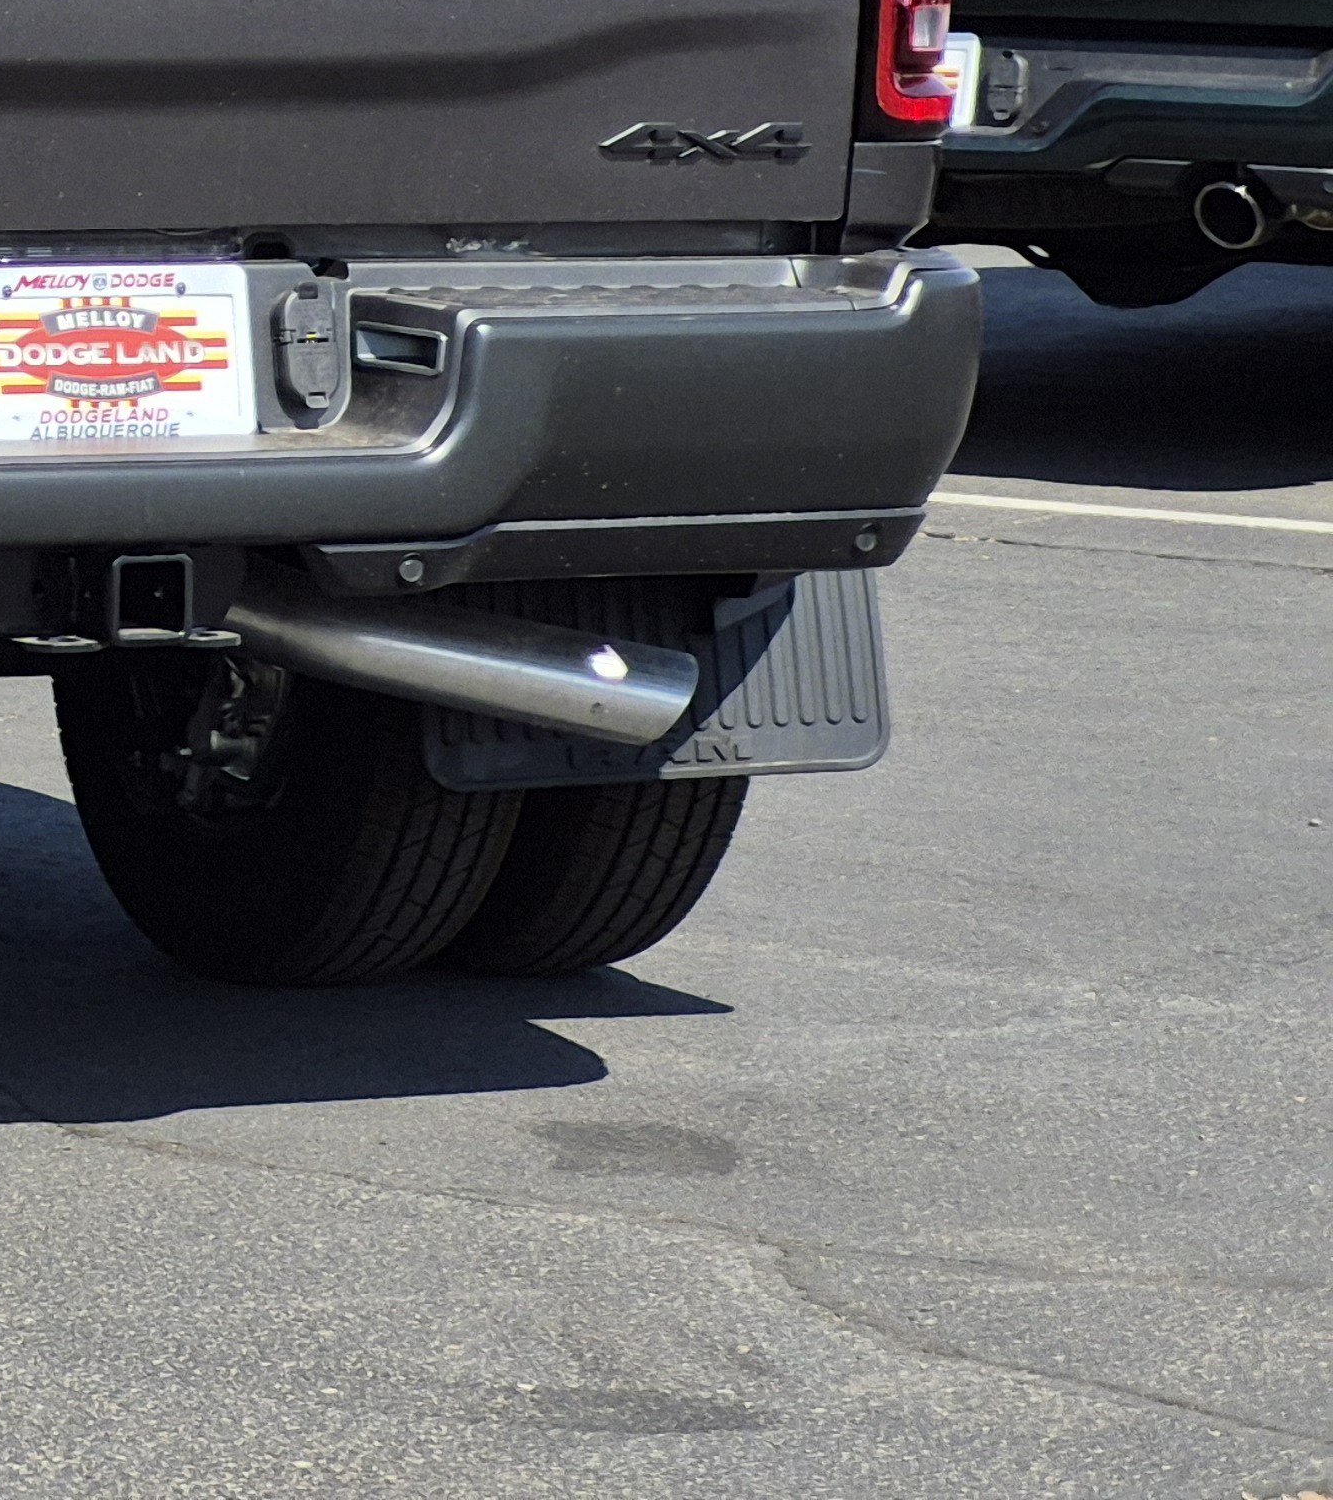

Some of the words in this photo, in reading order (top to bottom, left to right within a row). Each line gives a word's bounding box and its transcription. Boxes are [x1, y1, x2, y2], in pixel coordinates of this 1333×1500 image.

[14, 273, 91, 292] MELLOY
[111, 273, 176, 289] DODGE
[55, 309, 147, 331] MELLOY
[40, 408, 170, 424] DODGELAND
[30, 422, 181, 441] ALBUQUERQUE
